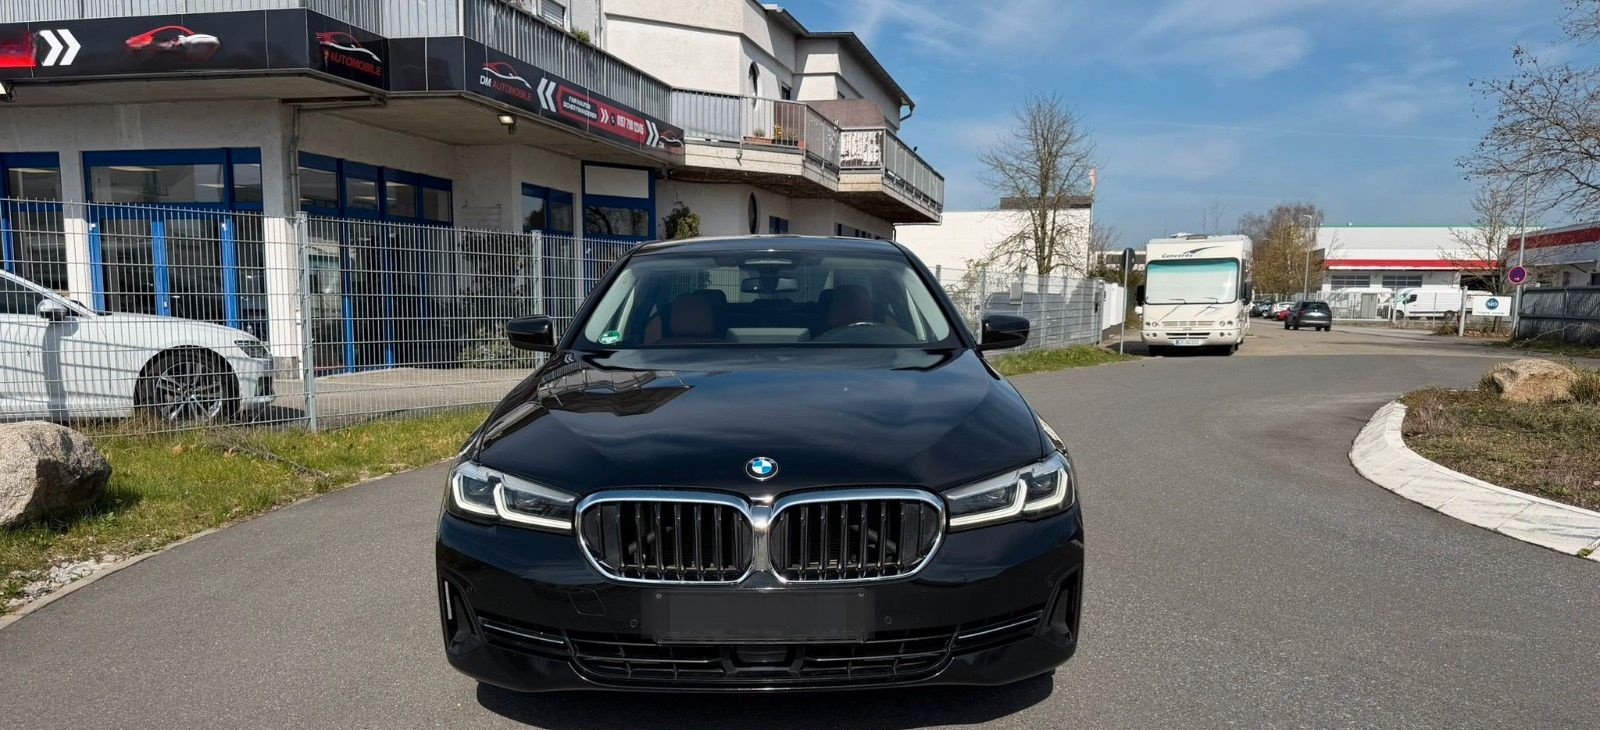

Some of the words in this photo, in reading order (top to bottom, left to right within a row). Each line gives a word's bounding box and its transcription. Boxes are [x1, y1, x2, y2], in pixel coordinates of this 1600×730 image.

[329, 51, 382, 76] AUTOMOBILE
[479, 74, 492, 88] DM
[491, 80, 532, 102] AUTOMOBILE
[1162, 251, 1193, 259] Concorde
